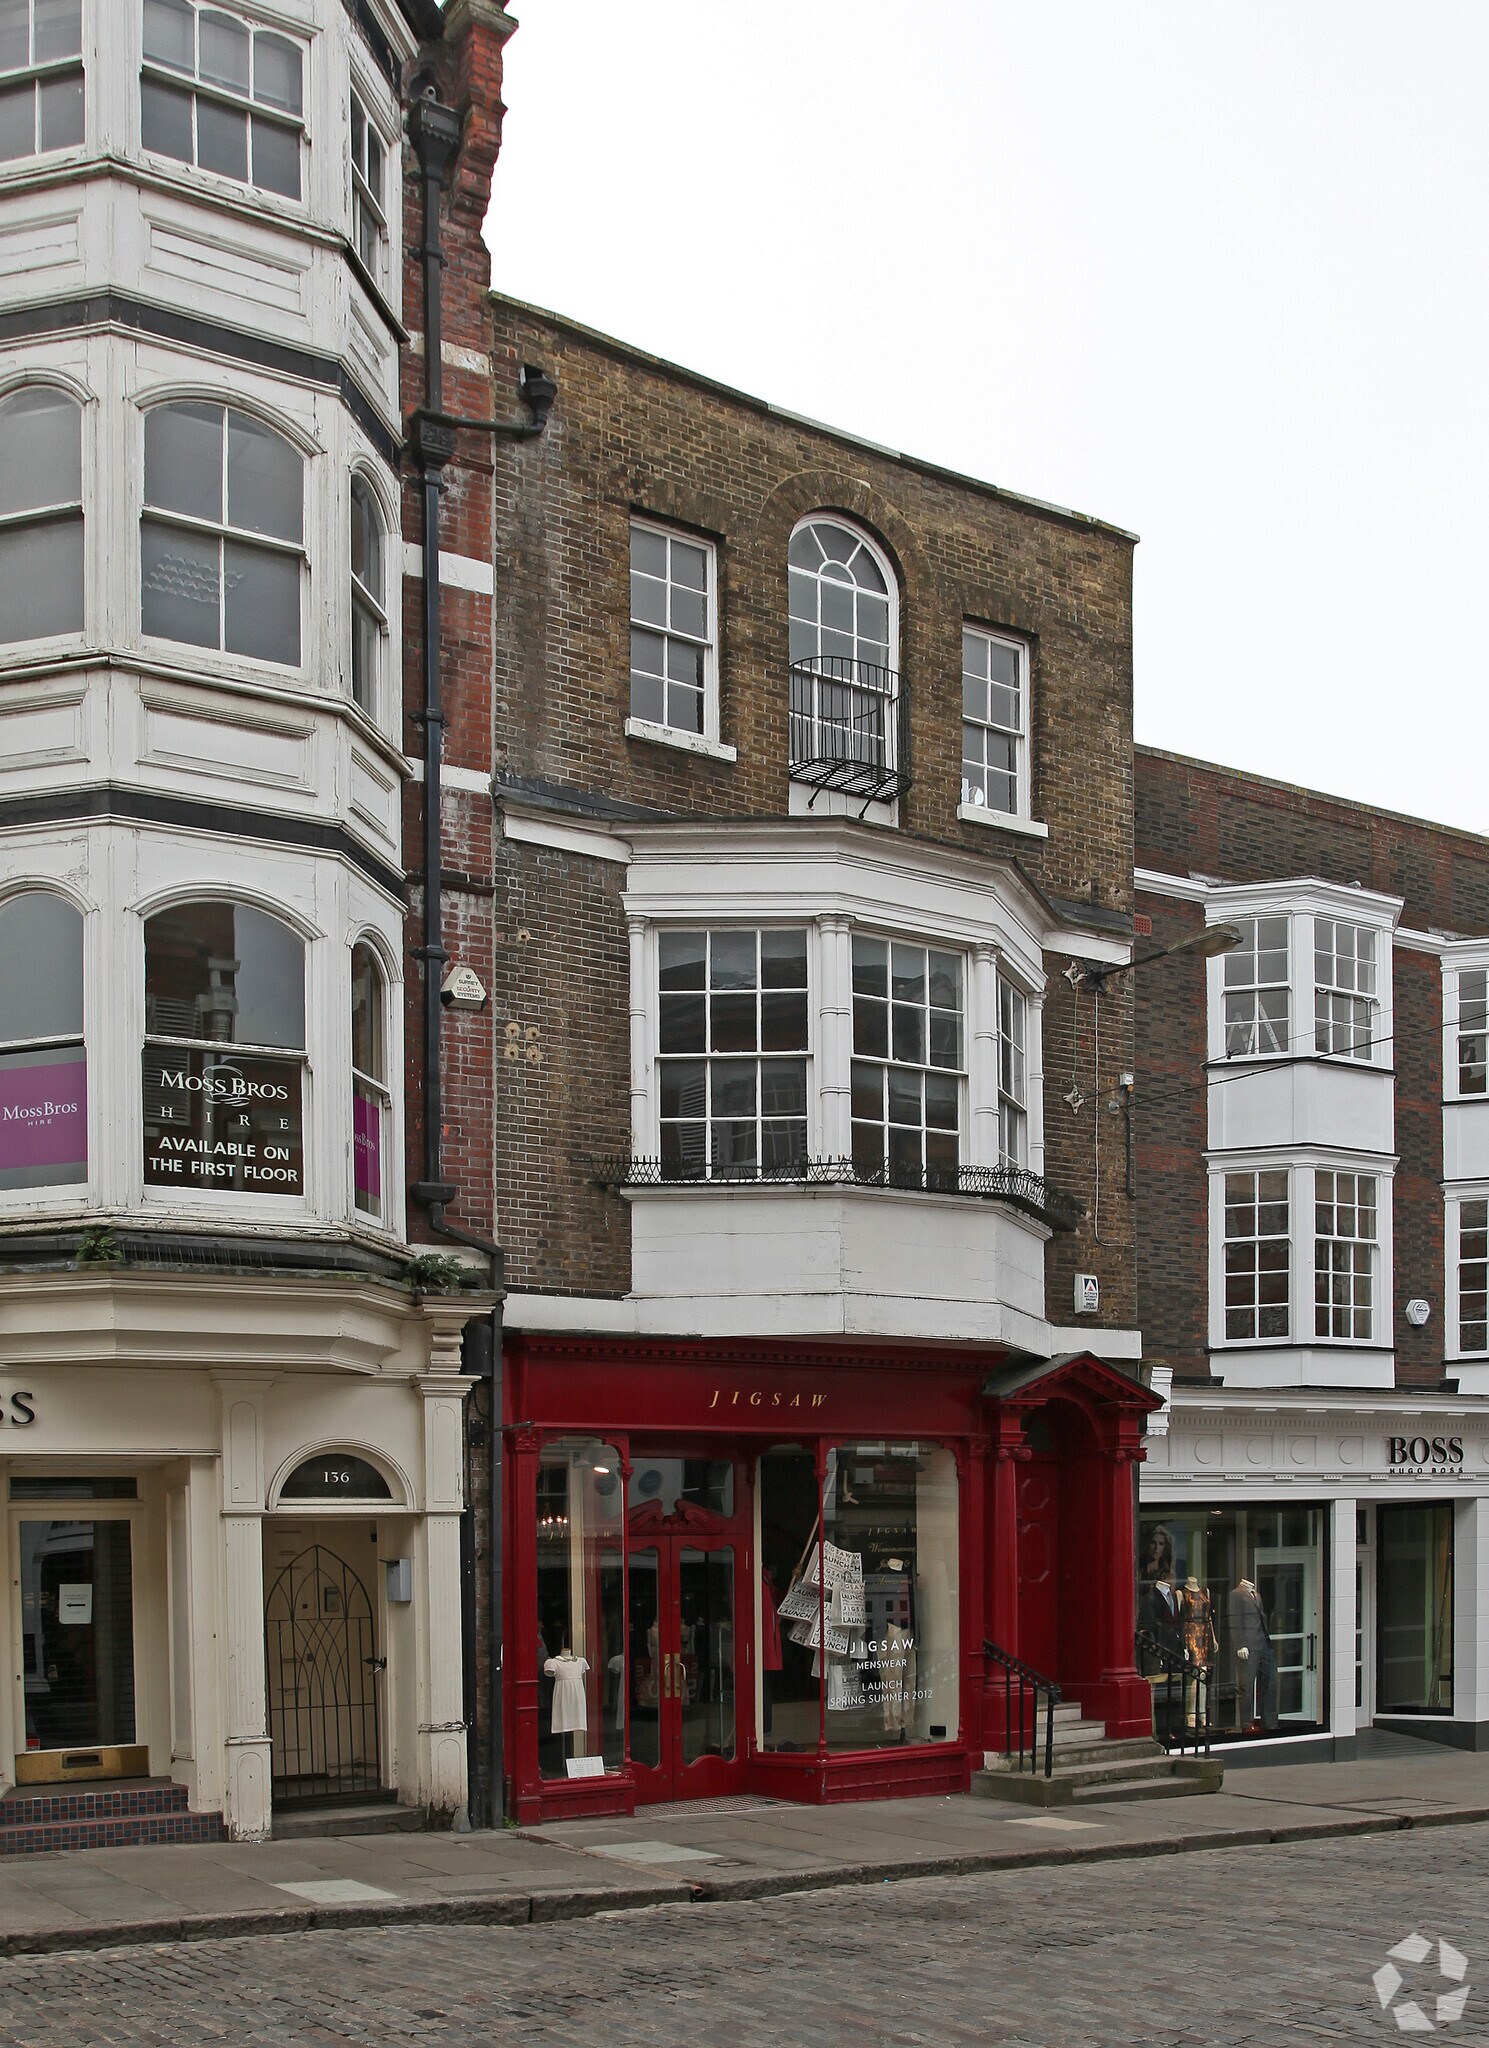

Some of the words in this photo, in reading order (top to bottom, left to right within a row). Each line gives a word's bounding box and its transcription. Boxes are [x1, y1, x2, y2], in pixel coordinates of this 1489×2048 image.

[160, 1069, 227, 1093] MOSS
[231, 1077, 288, 1100] BROS
[27, 1119, 52, 1127] HIRE
[159, 1136, 256, 1158] AVAILABLE
[263, 1146, 289, 1161] ON
[149, 1157, 183, 1173] THE
[191, 1161, 236, 1177] FIRST
[244, 1165, 298, 1182] FLOOR
[709, 1390, 827, 1408] JIGSAW
[1389, 1436, 1464, 1464] BOSS
[324, 1471, 350, 1483] 136
[779, 1608, 812, 1618] LAUNCH
[850, 1638, 914, 1653] JIGSAW
[856, 1659, 907, 1670] MENSWEAR
[862, 1680, 903, 1692] LAUNCH
[830, 1694, 866, 1707] SPRING
[868, 1691, 909, 1704] SUMMER
[912, 1690, 933, 1700] 2012
